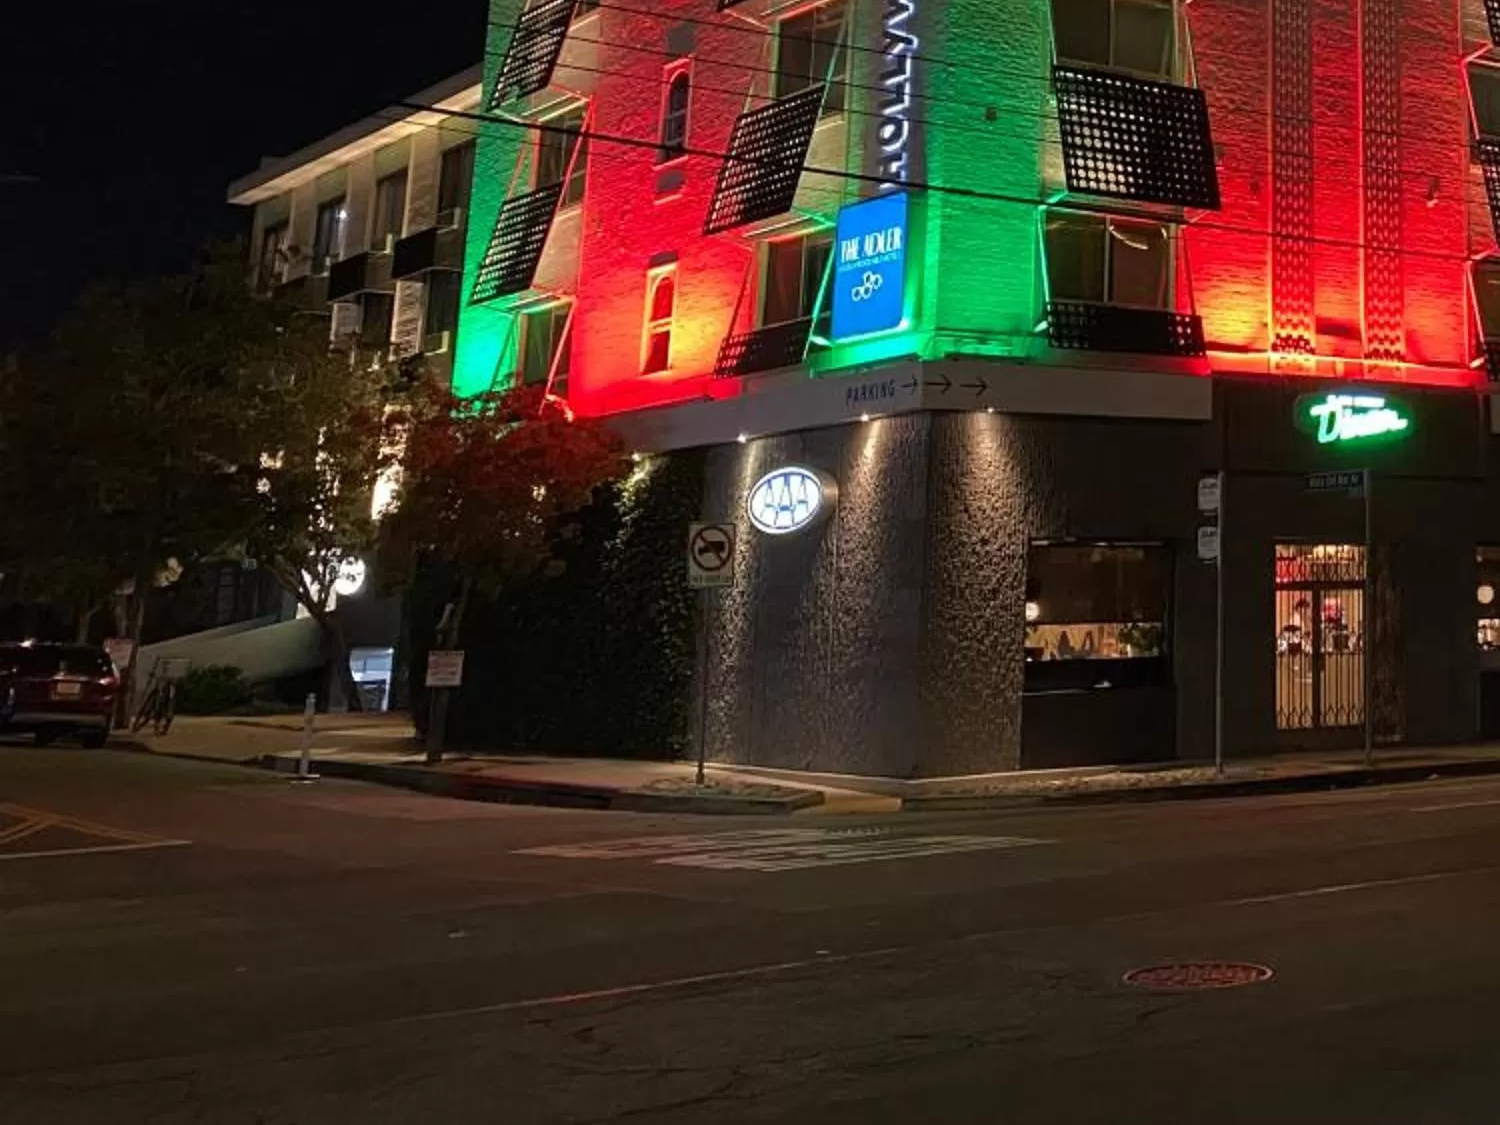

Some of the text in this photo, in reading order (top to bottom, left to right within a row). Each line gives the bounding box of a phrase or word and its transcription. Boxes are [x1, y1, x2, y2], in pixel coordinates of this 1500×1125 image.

[841, 236, 861, 264] THE
[864, 226, 902, 256] ADLER
[845, 378, 896, 407] PARKING
